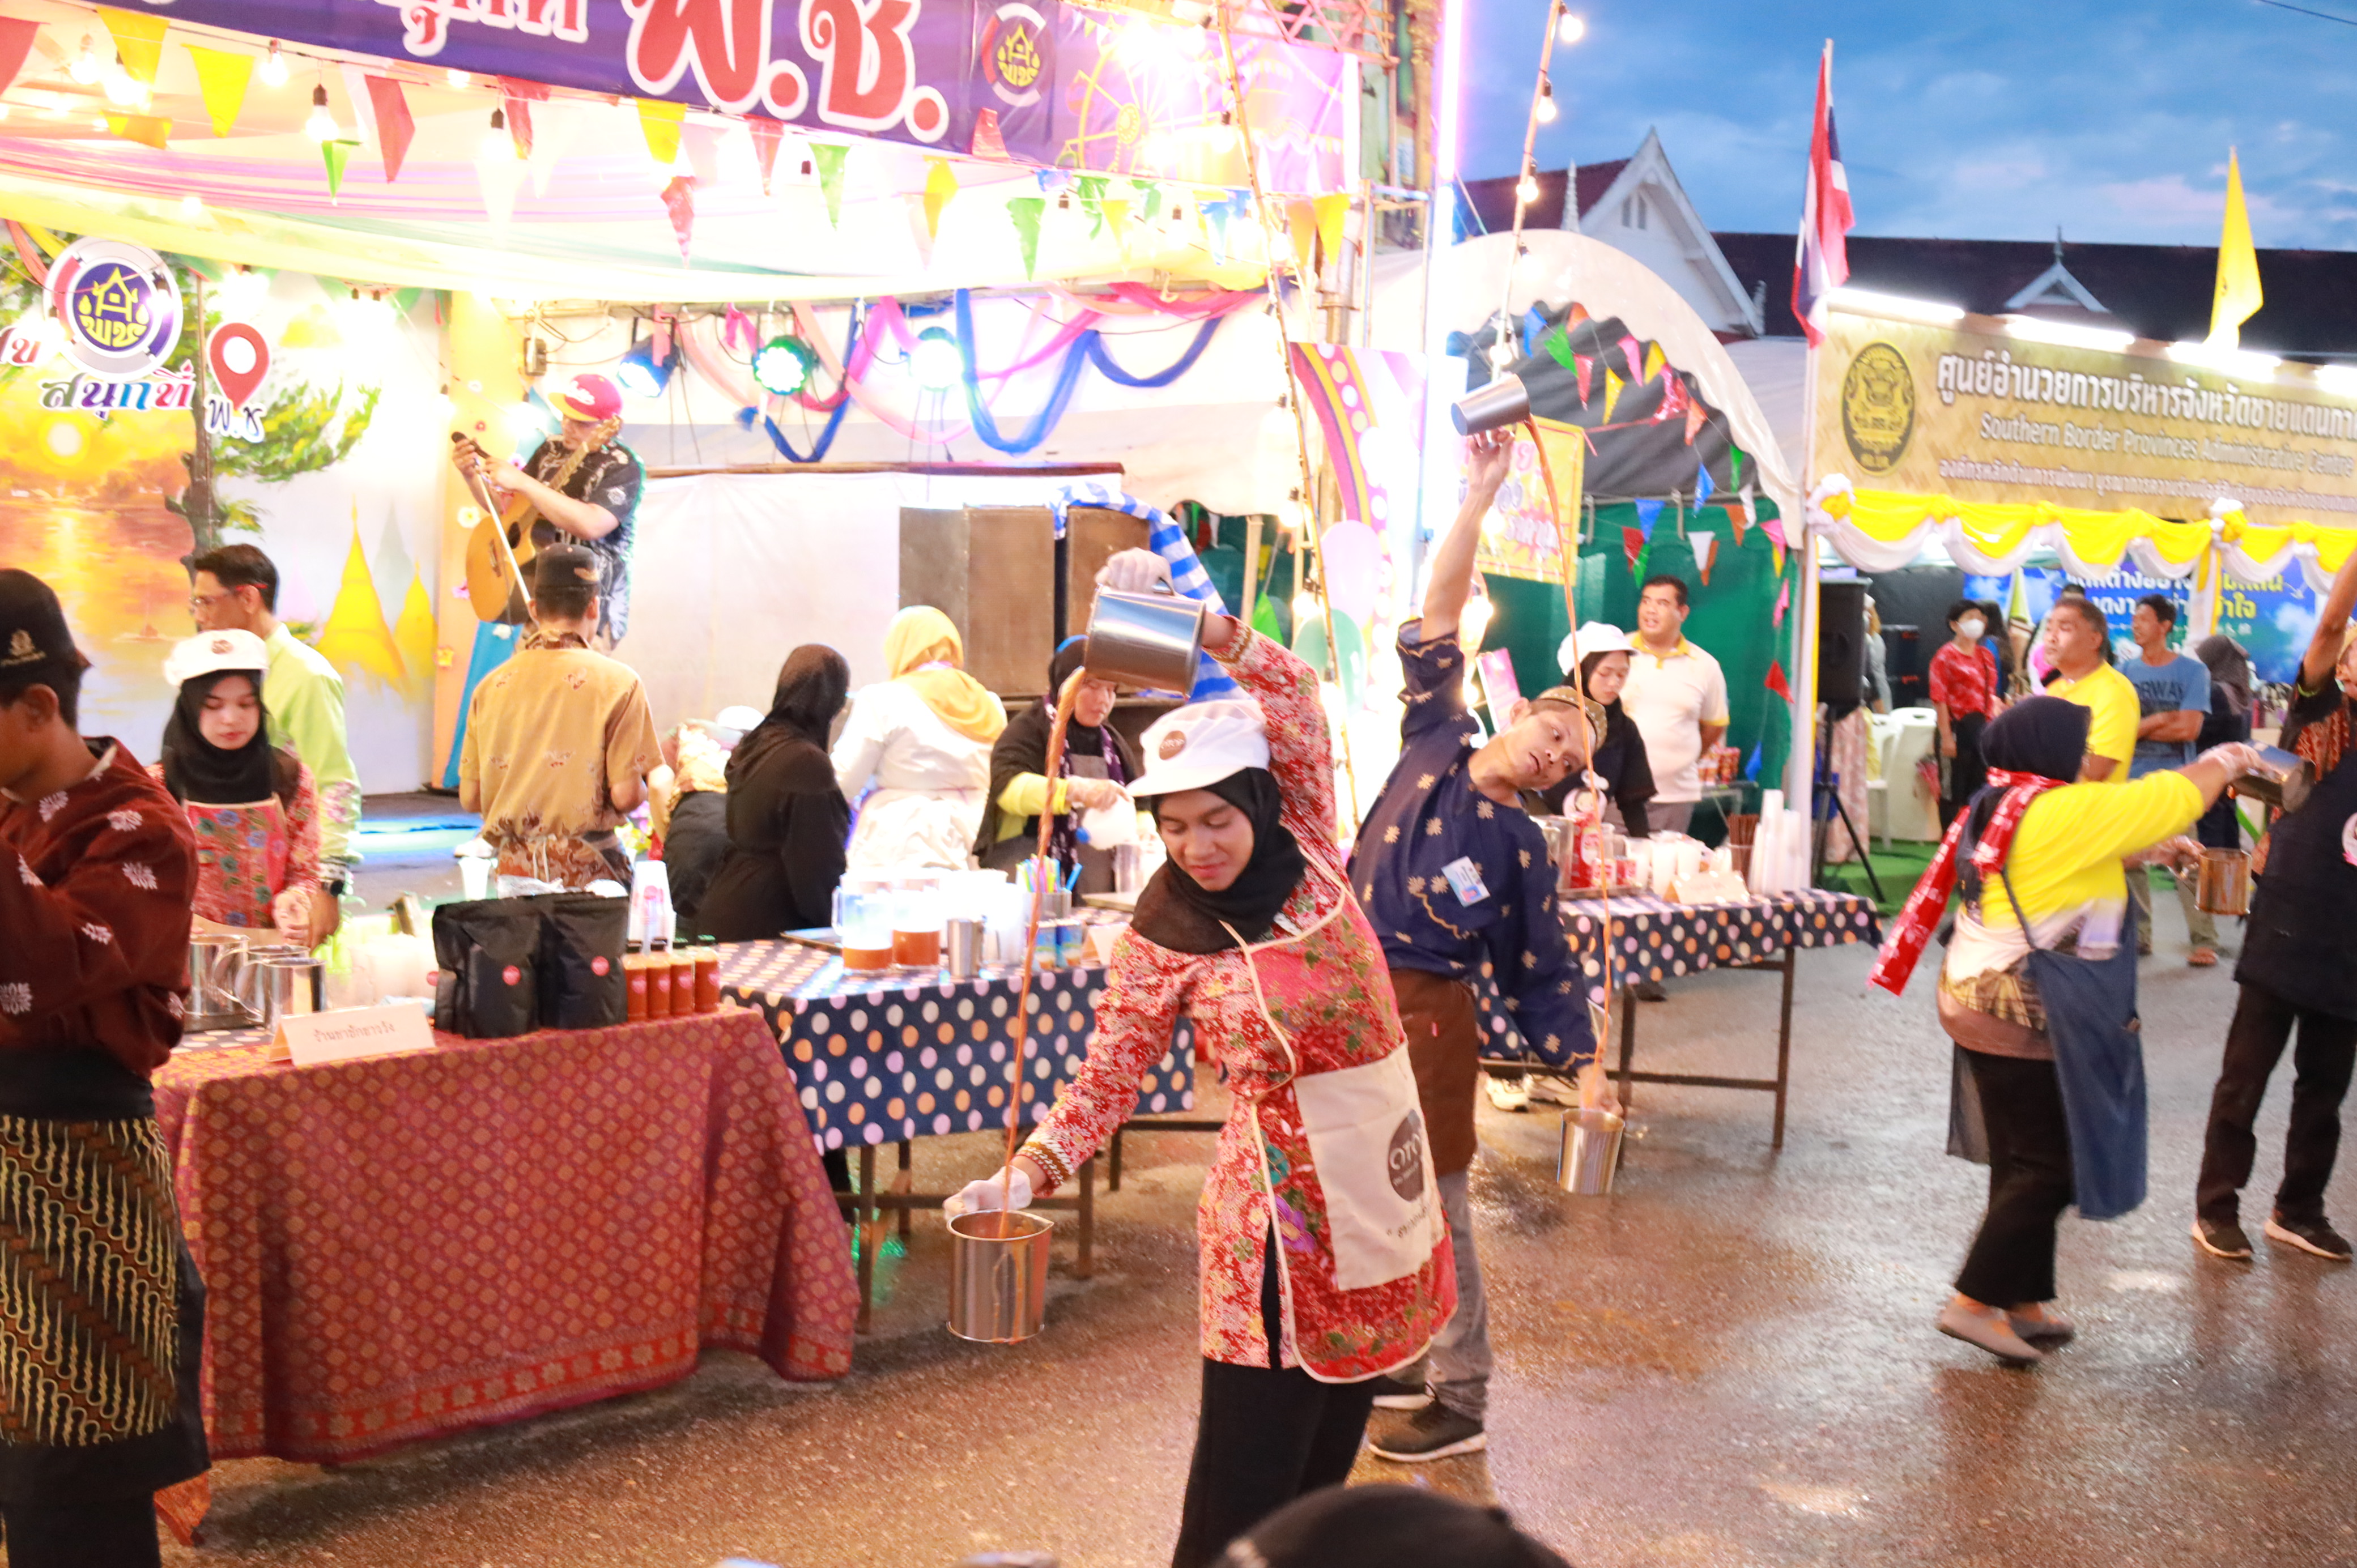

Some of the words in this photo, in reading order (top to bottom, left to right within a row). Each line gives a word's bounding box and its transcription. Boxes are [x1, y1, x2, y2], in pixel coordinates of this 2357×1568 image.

[41, 359, 195, 421] สนุกที่
[1937, 349, 2357, 442] ศูนย์อำนวยการบริหารจังหวัดชายแดนภา
[1980, 411, 2060, 446] Southern
[2063, 421, 2121, 453] Border
[2123, 428, 2198, 461] Provinces
[2198, 435, 2305, 472] Administrative
[2307, 449, 2354, 478] Centre
